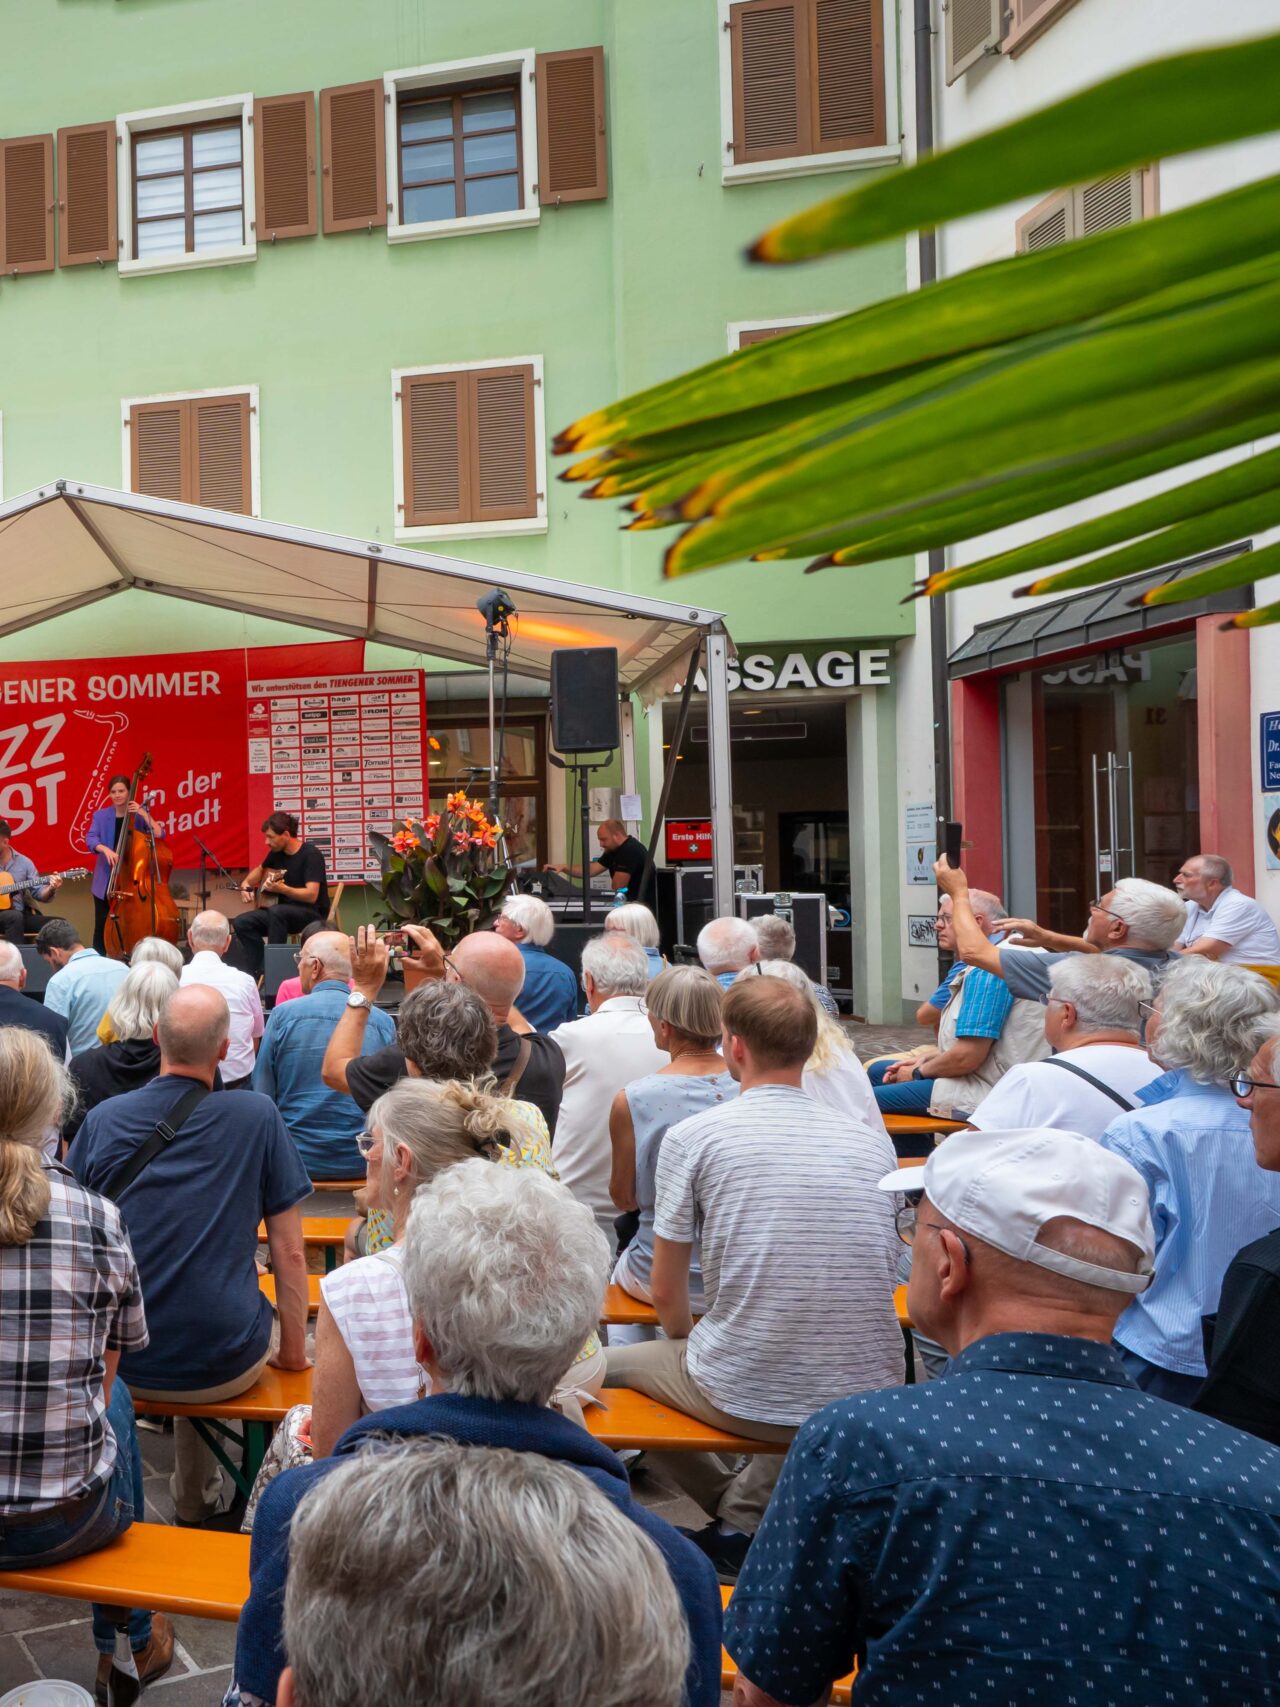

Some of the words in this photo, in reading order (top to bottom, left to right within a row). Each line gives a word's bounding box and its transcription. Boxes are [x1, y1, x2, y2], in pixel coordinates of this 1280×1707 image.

[251, 684, 264, 693] Wir
[313, 680, 327, 689] den
[329, 676, 374, 688] TIENGENER
[673, 649, 890, 692] ASSAGE
[87, 670, 221, 701] SOMMER
[177, 770, 222, 799] der
[672, 833, 694, 841] Erste
